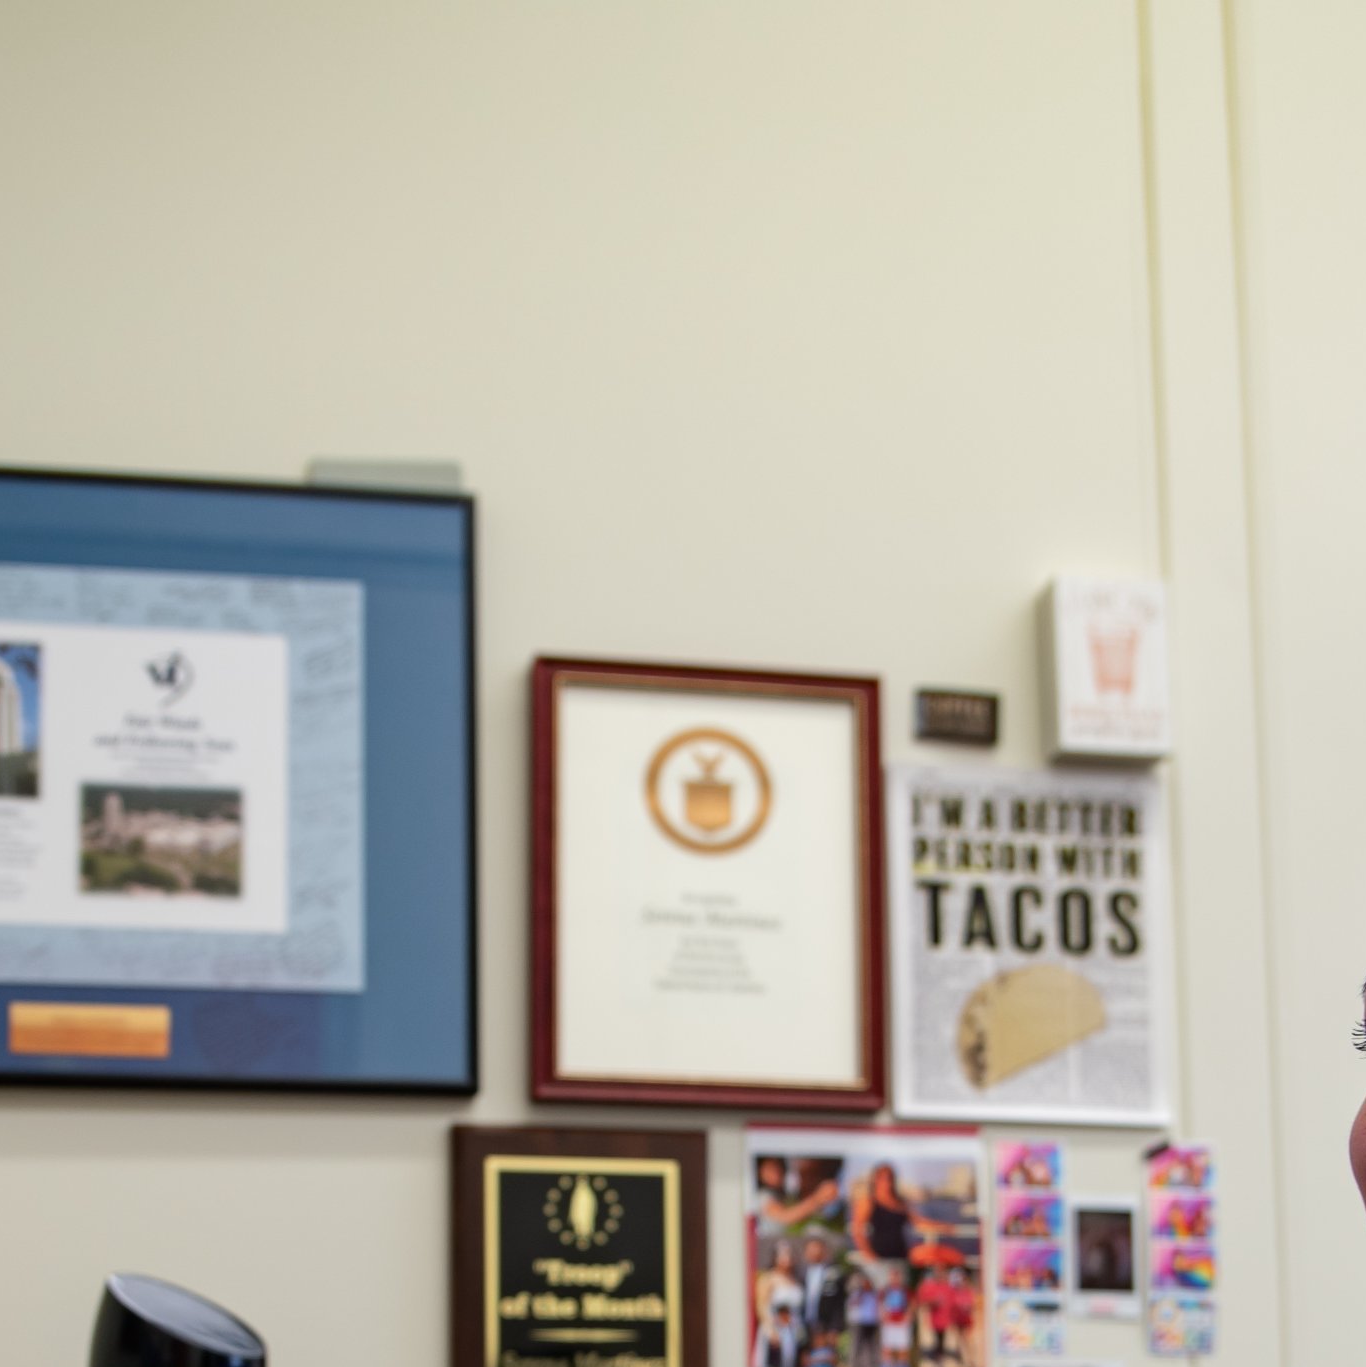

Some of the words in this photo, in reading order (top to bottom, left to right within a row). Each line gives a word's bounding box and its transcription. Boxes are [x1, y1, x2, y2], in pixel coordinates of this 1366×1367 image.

[913, 795, 964, 830] I'M
[979, 800, 998, 831] A
[1011, 799, 1140, 838] BETTER
[913, 837, 1037, 875] PERSON
[1056, 844, 1140, 880] WITH
[916, 878, 1140, 958] TACOS
[533, 1291, 577, 1320] the
[581, 1292, 665, 1321] Month
